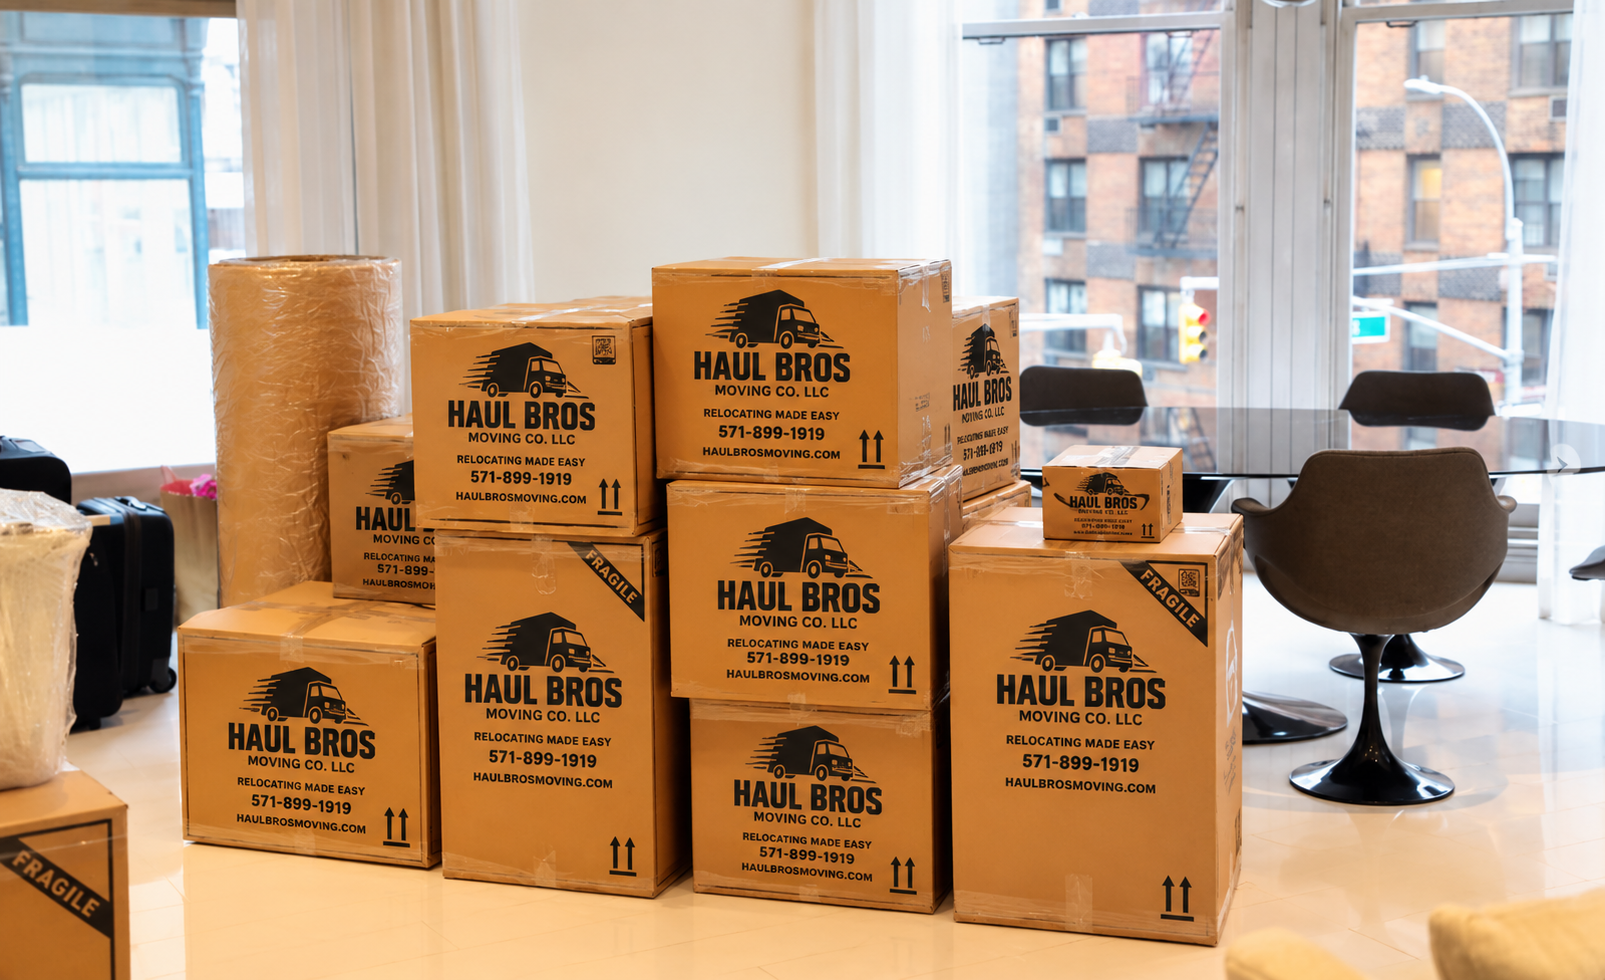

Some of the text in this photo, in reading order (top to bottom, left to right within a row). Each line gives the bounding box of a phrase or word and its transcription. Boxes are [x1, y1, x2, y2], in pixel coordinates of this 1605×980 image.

[694, 351, 851, 383] HAUL BROS
[715, 385, 829, 398] MOVING CO. LLC
[953, 381, 981, 411] HAUL
[984, 377, 1012, 406] BROS
[448, 400, 596, 431] HAUL BROS
[703, 408, 840, 421] RELOCATING MADE EASY
[995, 406, 1004, 417] LLC
[469, 432, 575, 445] MOVING CO. LLC
[718, 425, 825, 441] 571-899-1919
[457, 455, 585, 467] RELOCATING MADE EASY
[702, 447, 840, 460] HAULBROSMOVING.COM
[471, 470, 572, 485] 571-899-1919
[456, 491, 586, 505] HAULBROSMOVING.COM
[1070, 496, 1137, 509] HAUL BROS
[356, 506, 416, 532] HAUL
[373, 534, 420, 544] MOVING
[364, 552, 420, 562] RELOCATING
[586, 550, 638, 605] FRAGILE
[717, 580, 880, 614] HAUL BROS
[1139, 569, 1200, 628] FRAGILE
[740, 615, 857, 629] MOVING CO. LLC
[728, 638, 869, 651] RELOCATING MADE EASY
[747, 652, 849, 666] 571-899-1919
[727, 669, 869, 683] HAULBROSMOVING.COM
[464, 674, 622, 708] HAUL BROS
[997, 674, 1166, 709] HAUL BROS
[486, 707, 600, 723] MOVING CO. LLC
[1019, 710, 1142, 726] MOVING CO. LLC
[228, 722, 376, 760] HAUL BROS
[474, 732, 612, 747] RELOCATING MADE EASY
[1006, 735, 1155, 750] RELOCATING MADE EASY
[248, 754, 355, 774] MOVING CO. LLC
[489, 749, 597, 768] 571-899-1919
[1022, 754, 1139, 772] 571-899-1919
[237, 776, 366, 796] RELOCATING MADE EASY
[473, 772, 613, 789] HAULBROSMOVING.COM
[1006, 777, 1156, 794] HAULBROSMOVING.COM
[251, 793, 352, 815] 571-899-1919
[734, 779, 882, 815] HAUL BROS
[236, 813, 367, 835] HAULBROSMOVING.COM
[754, 811, 861, 828] MOVING CO. LLC
[743, 832, 872, 849] RELOCATING MADE EASY
[759, 846, 855, 865] 571-899-1919
[742, 862, 872, 882] HAULBROSMOVING.COM
[12, 850, 100, 918] FRAGILE
